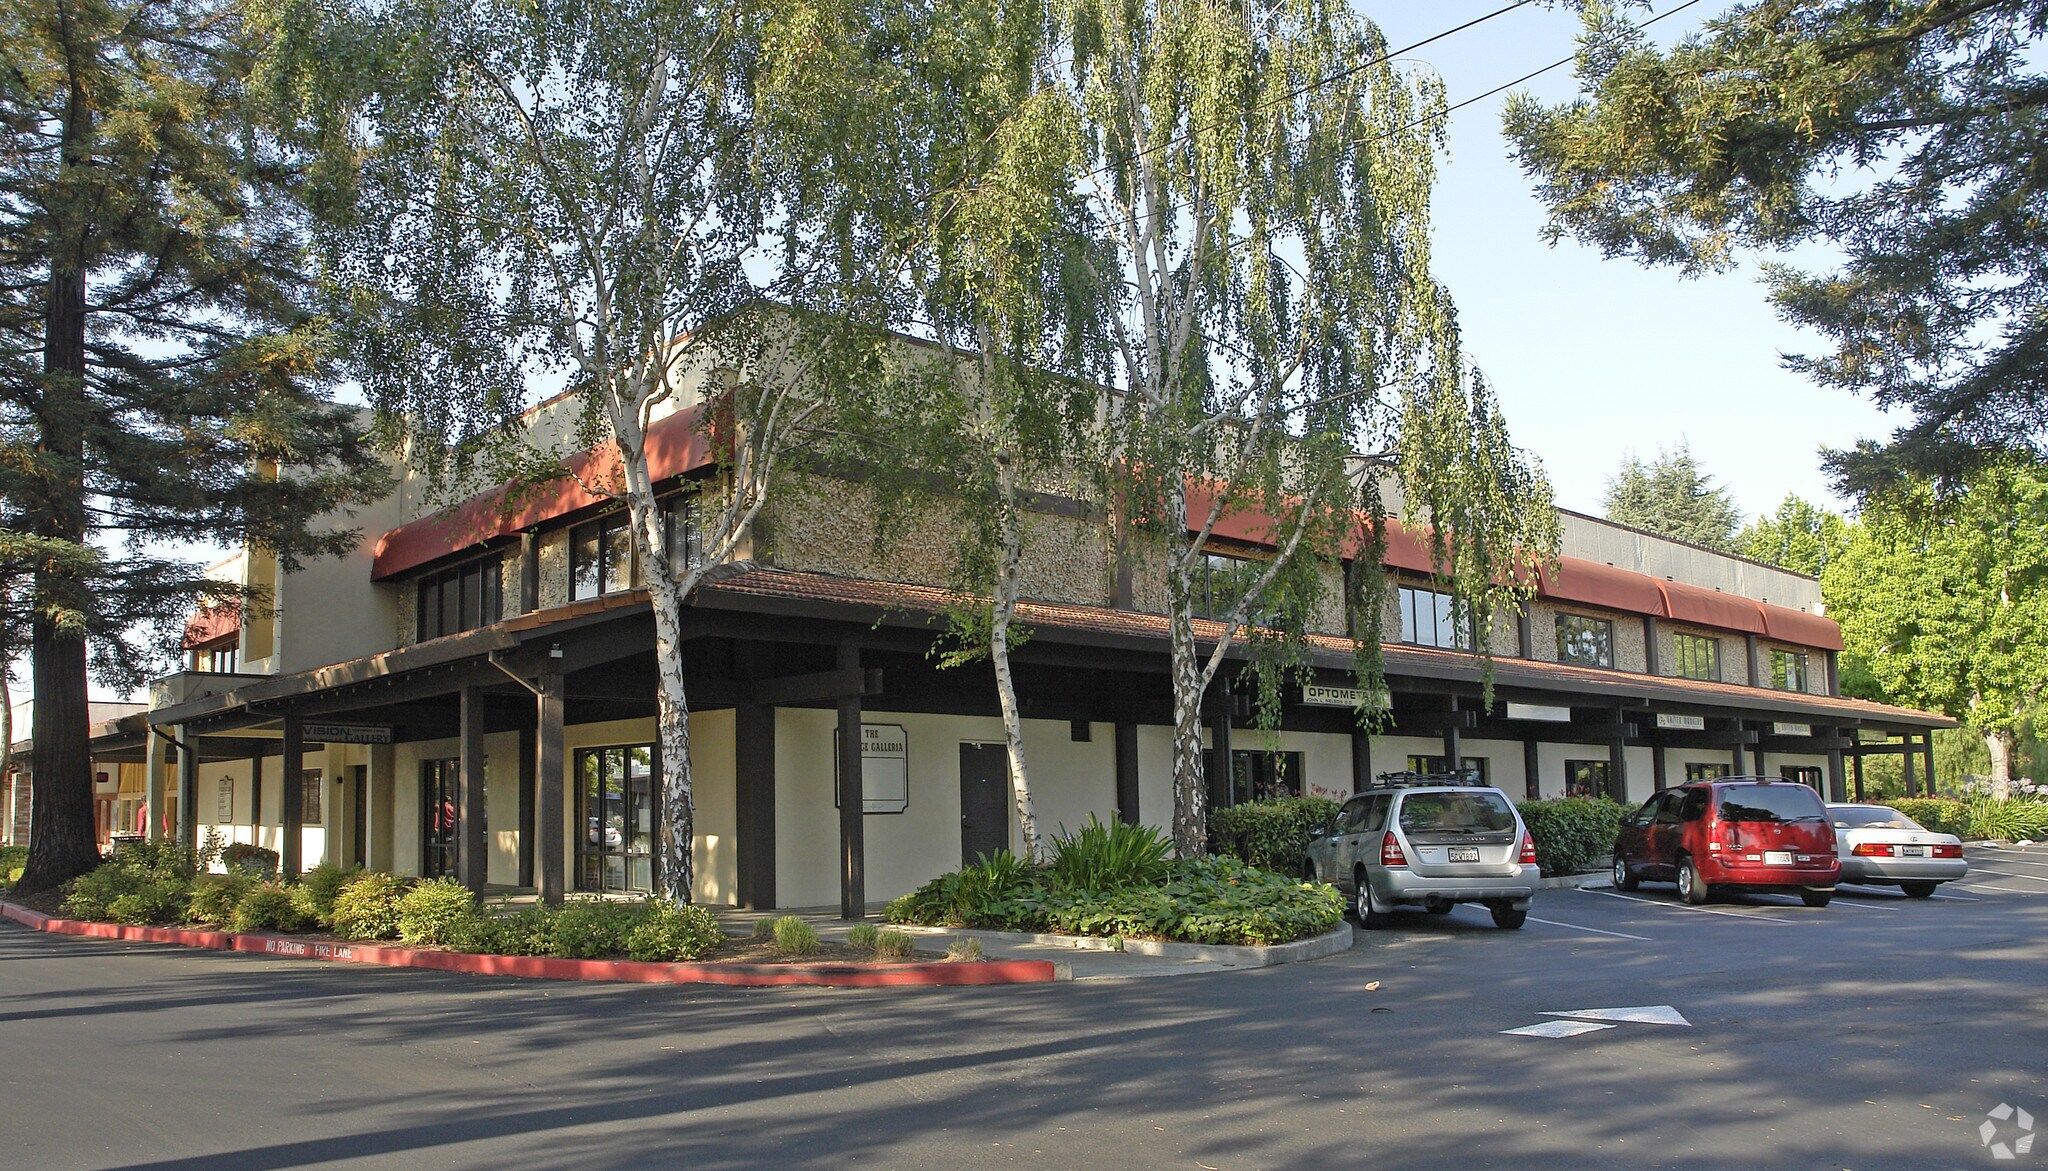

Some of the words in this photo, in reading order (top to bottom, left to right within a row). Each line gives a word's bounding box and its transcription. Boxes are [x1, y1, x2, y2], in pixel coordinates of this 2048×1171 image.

[303, 726, 350, 736] VISION
[865, 729, 879, 738] THE
[345, 734, 390, 743] GALLERY
[870, 742, 903, 752] GALLERIA
[266, 940, 275, 951] NO
[277, 941, 305, 954] PARKING
[315, 945, 330, 956] FIRE
[333, 946, 352, 958] LANE
